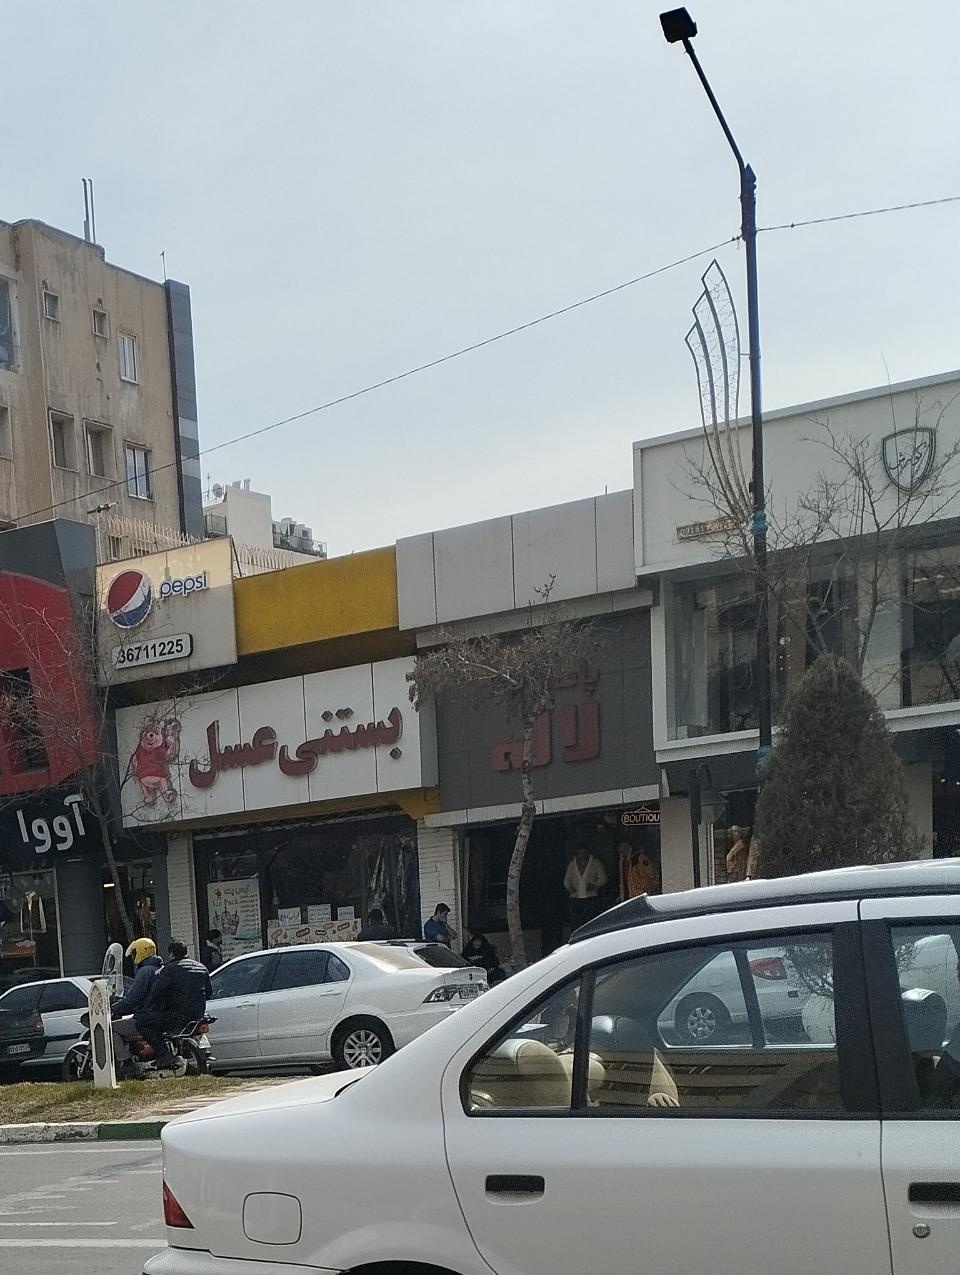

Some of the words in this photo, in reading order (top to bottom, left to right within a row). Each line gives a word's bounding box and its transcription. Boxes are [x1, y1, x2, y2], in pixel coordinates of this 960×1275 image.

[159, 570, 208, 600] pepsi
[118, 637, 184, 664] 36711225
[189, 719, 278, 788] عسل
[278, 707, 404, 777] بستنی
[490, 703, 601, 772] لاله
[623, 813, 660, 823] BOUTIQU
